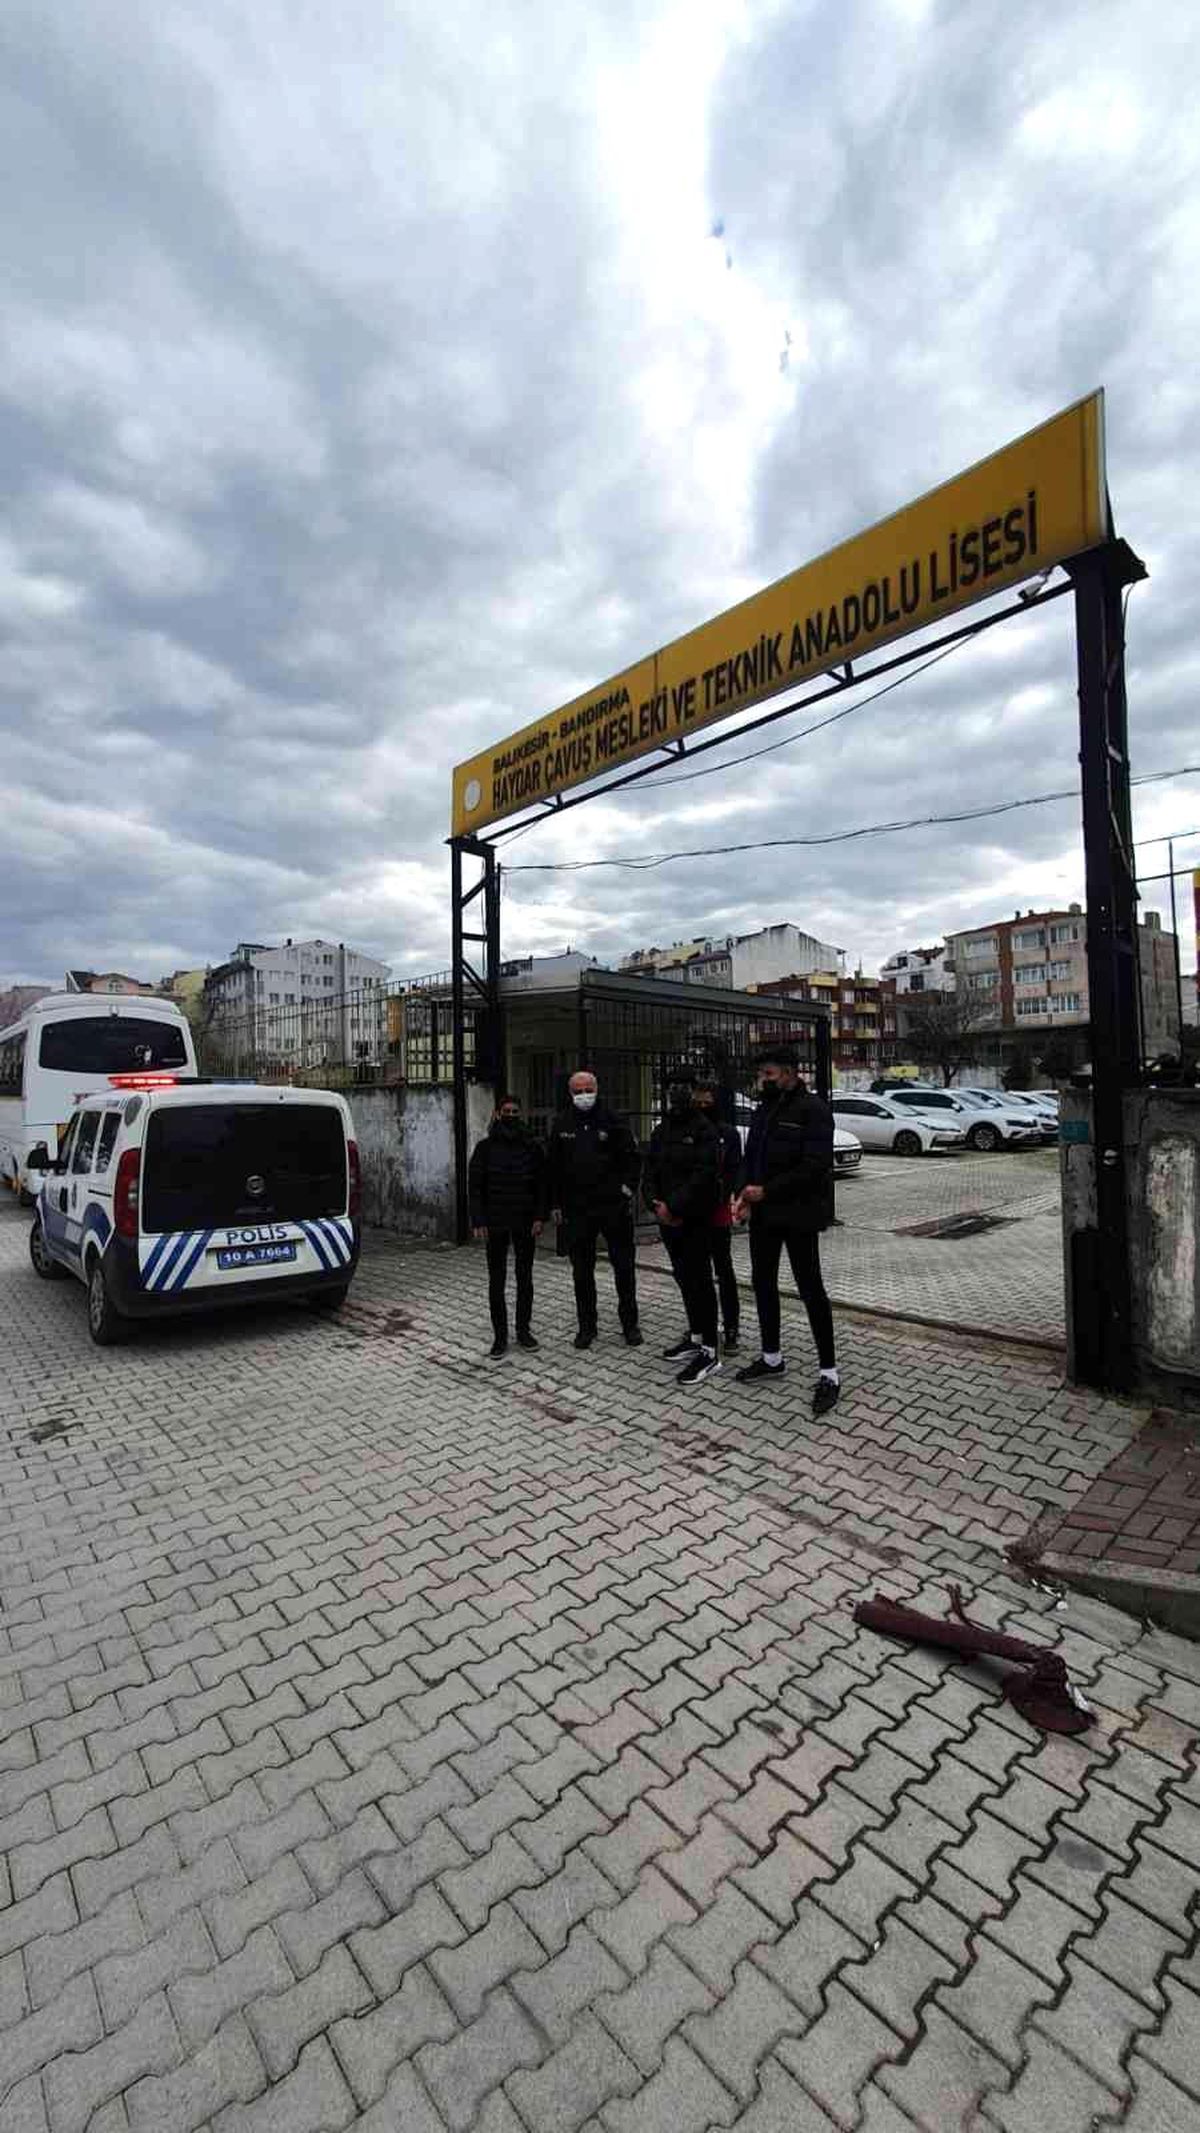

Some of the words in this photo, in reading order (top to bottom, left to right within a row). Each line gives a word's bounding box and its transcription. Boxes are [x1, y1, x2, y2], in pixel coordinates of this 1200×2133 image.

[492, 760, 540, 811] HAYDAR
[544, 733, 592, 790] ÇAVUŞ
[595, 686, 668, 758] MESLEKİ
[672, 676, 696, 725] VE
[703, 631, 783, 710] TEKNİK
[788, 560, 921, 671] ANADOLU
[928, 489, 1038, 603] LİSESİ
[560, 687, 630, 738] BANDIRMA
[245, 1249, 256, 1260] A
